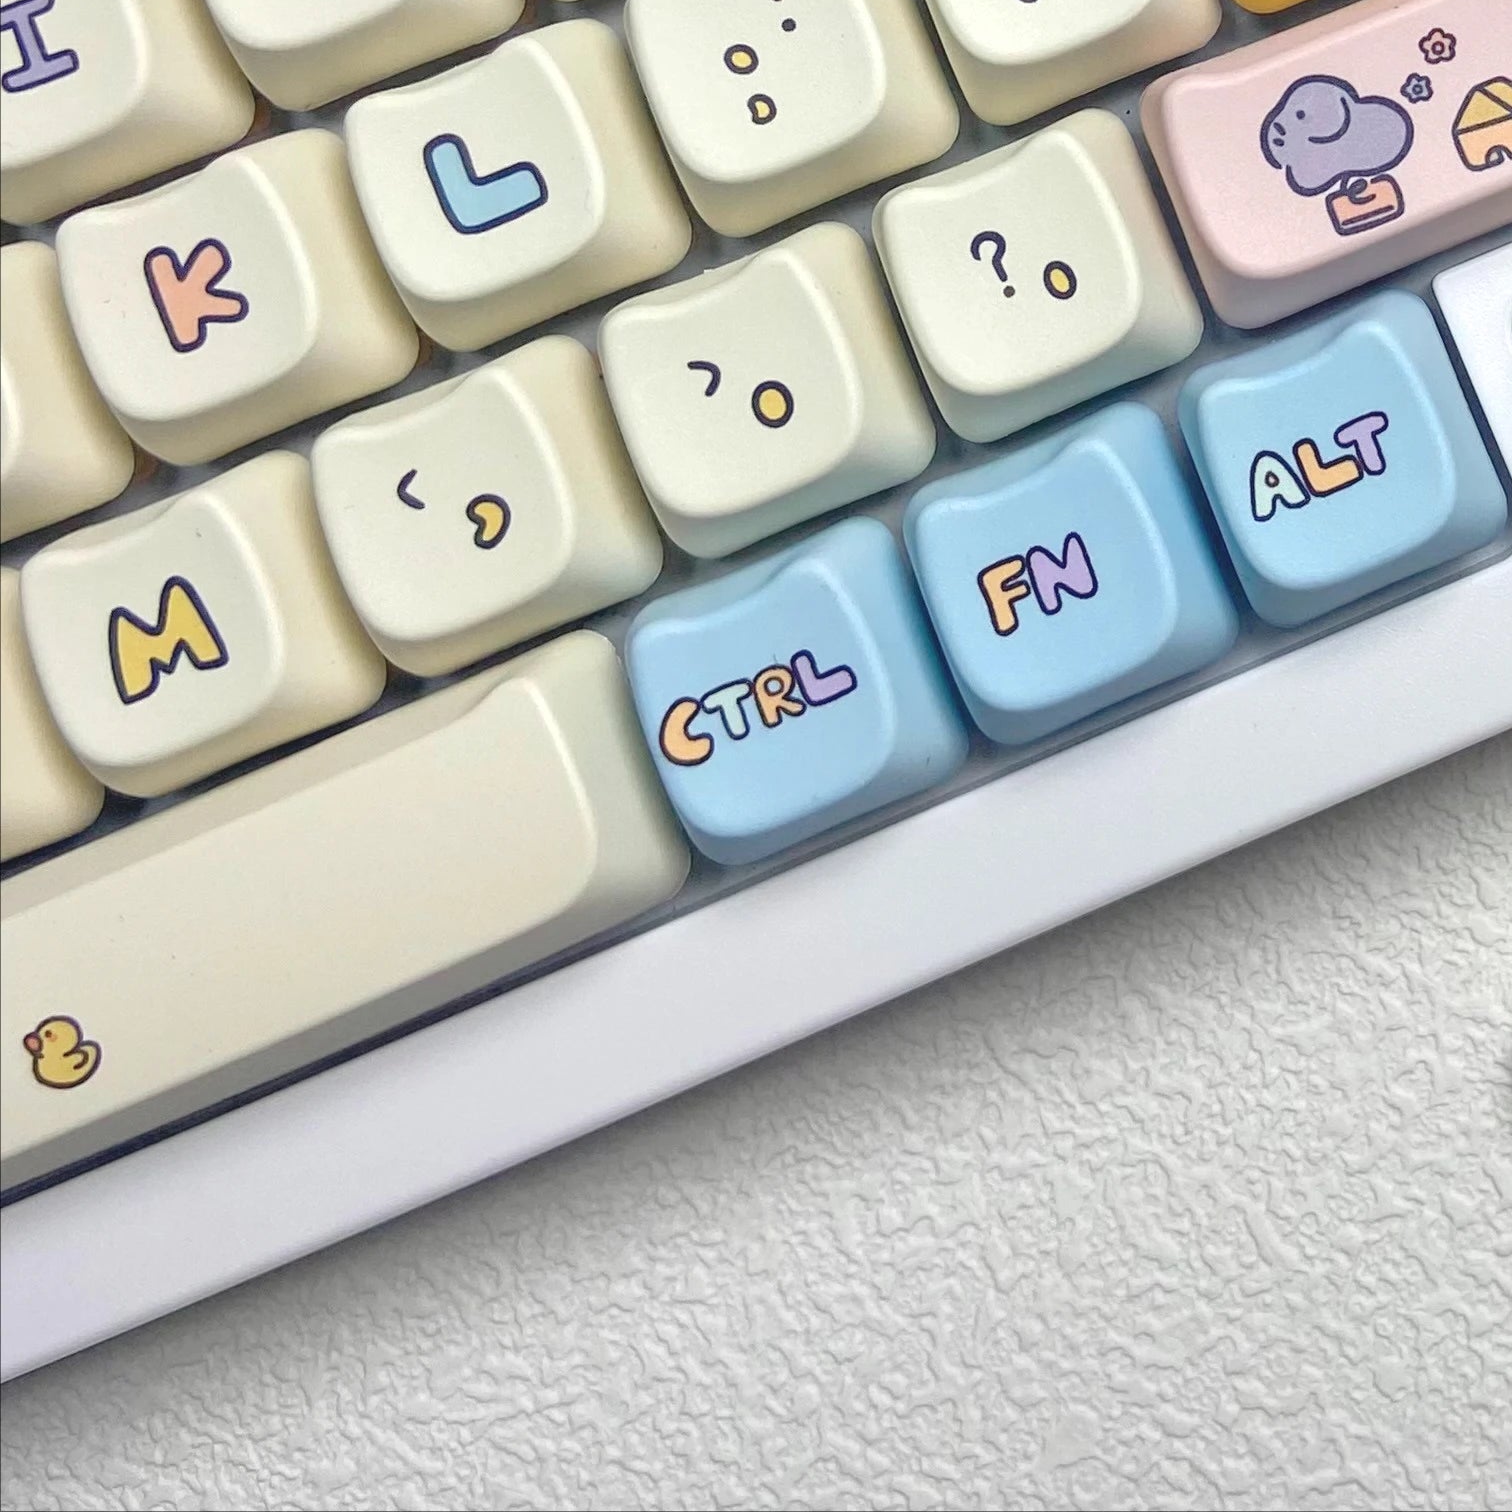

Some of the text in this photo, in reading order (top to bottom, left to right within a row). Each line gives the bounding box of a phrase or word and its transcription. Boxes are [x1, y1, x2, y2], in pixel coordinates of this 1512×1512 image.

[422, 131, 549, 235] L
[142, 236, 250, 354] K
[1248, 410, 1390, 523] ALT
[108, 575, 229, 706] M
[976, 530, 1100, 638] FN
[658, 648, 858, 768] CTRL
